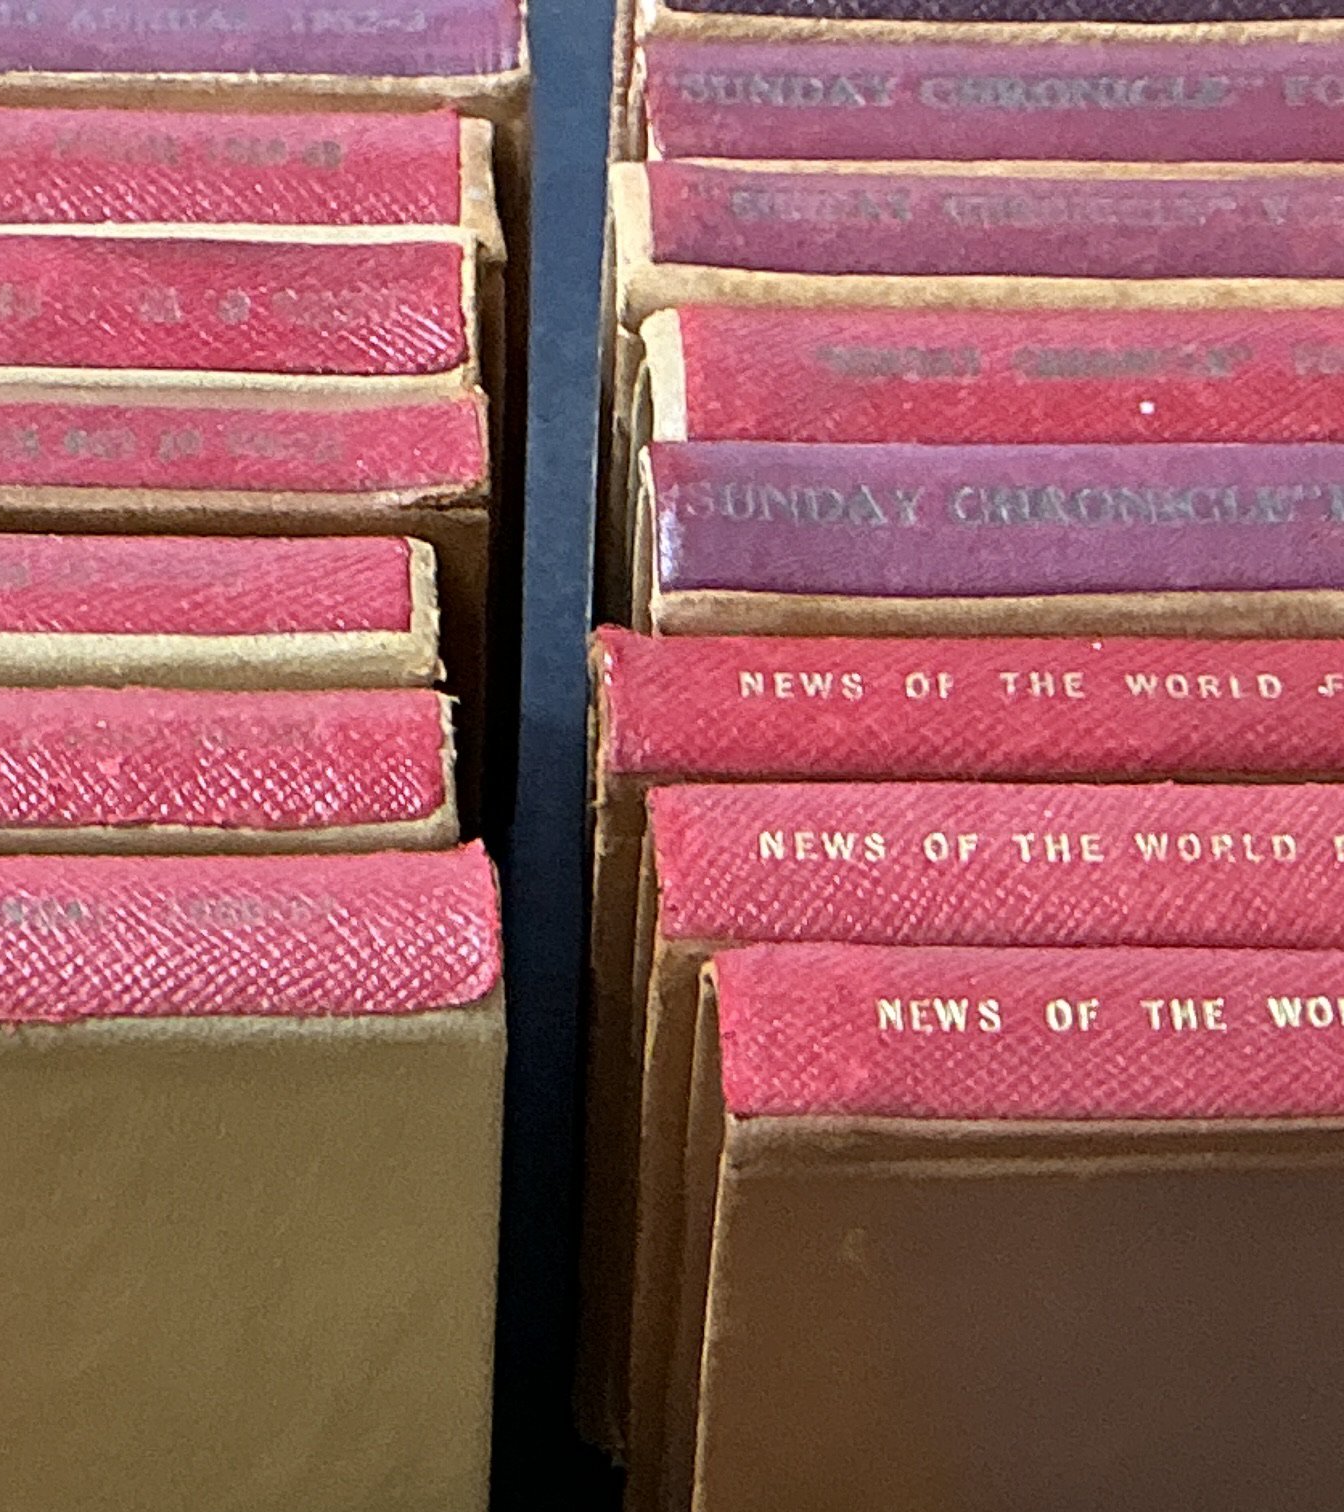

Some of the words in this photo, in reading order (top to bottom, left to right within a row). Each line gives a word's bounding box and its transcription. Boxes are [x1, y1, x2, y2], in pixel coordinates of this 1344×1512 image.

[739, 671, 863, 700] NEWS
[905, 671, 952, 700] OF
[1000, 671, 1085, 699] THE
[1124, 672, 1282, 700] WORLD
[759, 831, 887, 861] NEWS
[923, 832, 978, 861] OF
[1012, 832, 1104, 862] THE
[1135, 833, 1297, 862] WORLD
[876, 998, 1001, 1032] NEWS
[1045, 998, 1099, 1031] OF
[1144, 998, 1226, 1031] THE
